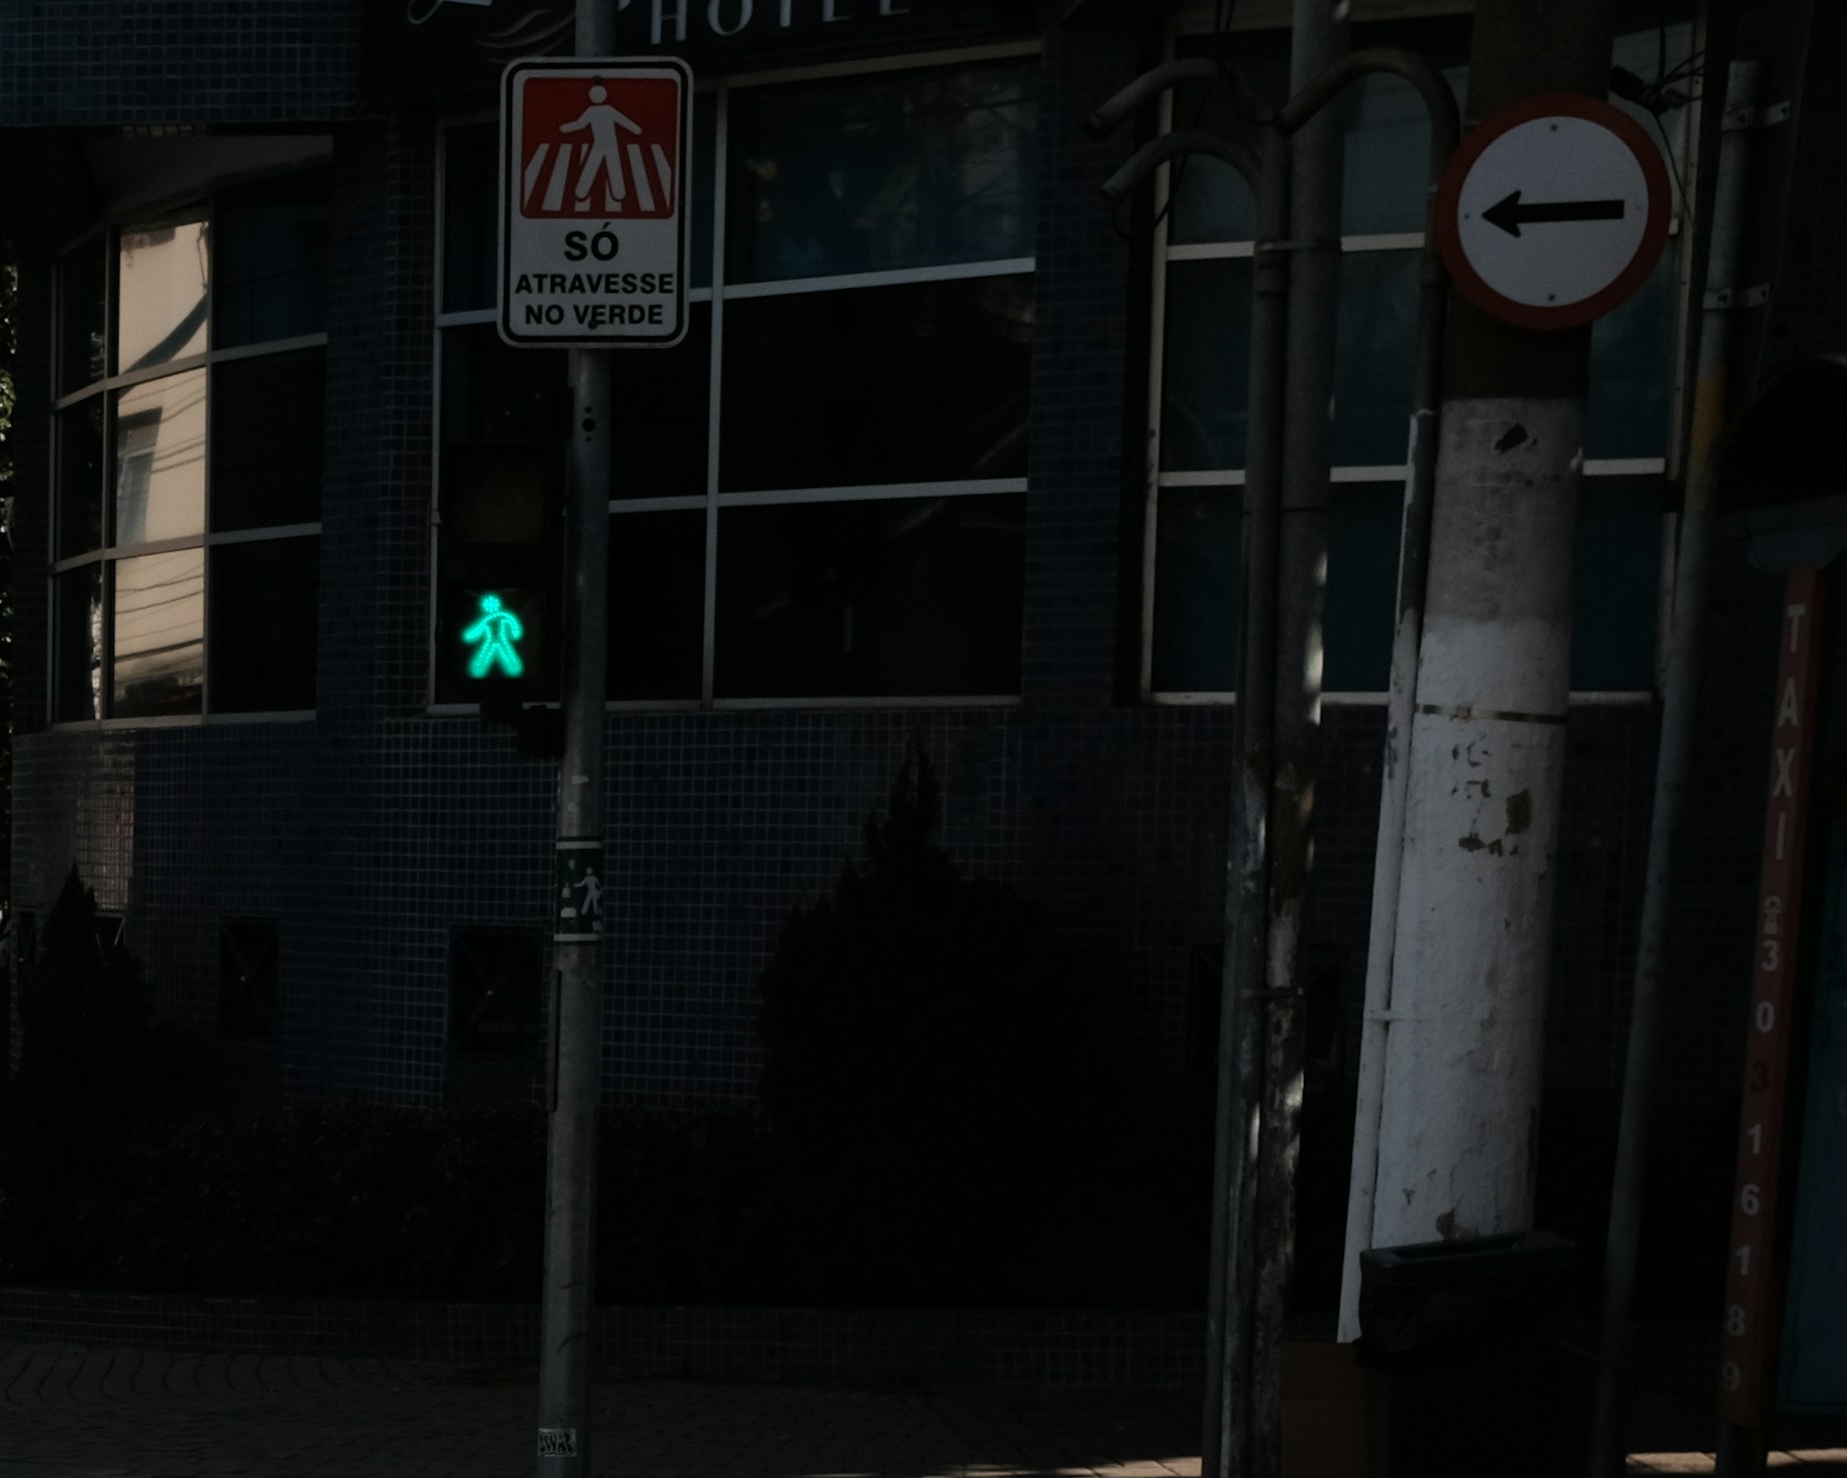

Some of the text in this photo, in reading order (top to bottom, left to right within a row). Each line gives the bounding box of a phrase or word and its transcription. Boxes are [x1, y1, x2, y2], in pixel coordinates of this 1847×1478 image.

[564, 221, 619, 261] SÓ
[515, 273, 674, 294] ATRAVESSE
[525, 304, 663, 325] NO VERDE
[1775, 604, 1806, 861] TAXI
